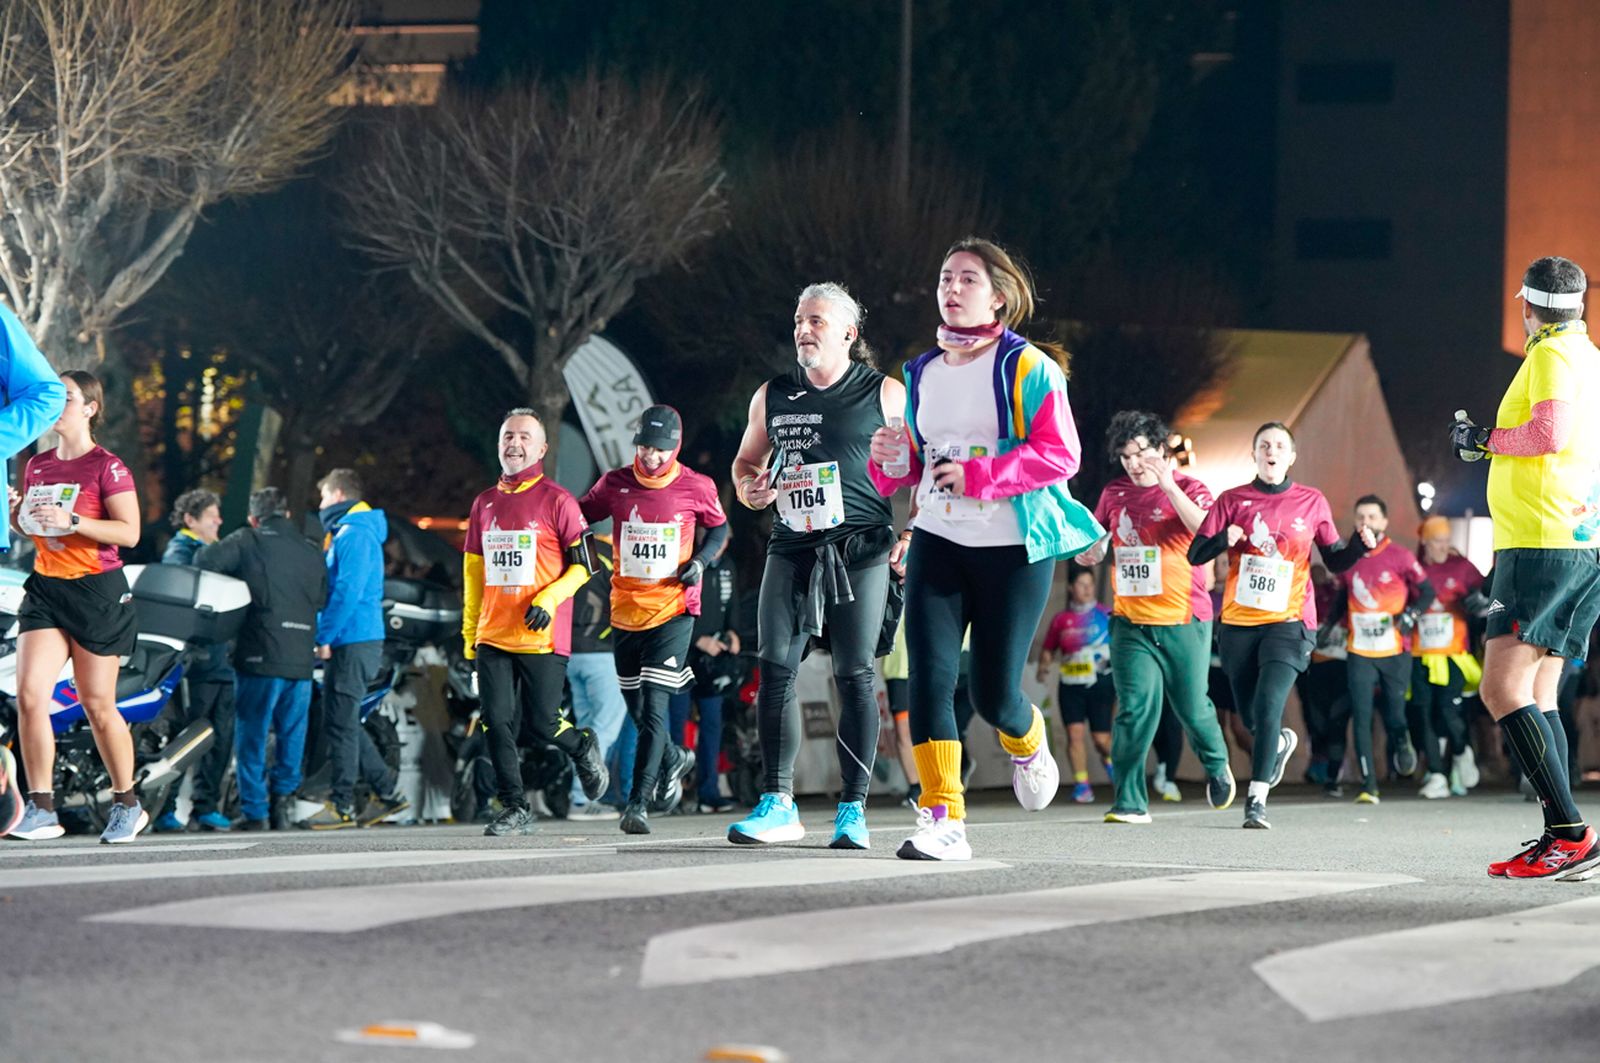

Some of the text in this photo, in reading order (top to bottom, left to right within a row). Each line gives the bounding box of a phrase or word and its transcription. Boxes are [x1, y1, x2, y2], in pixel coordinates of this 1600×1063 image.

[804, 471, 812, 479] DE
[782, 482, 792, 490] SAN
[788, 487, 826, 509] 1764
[492, 551, 522, 567] 4415
[632, 543, 666, 559] 4414
[1121, 564, 1149, 578] 5419
[1249, 574, 1276, 592] 588
